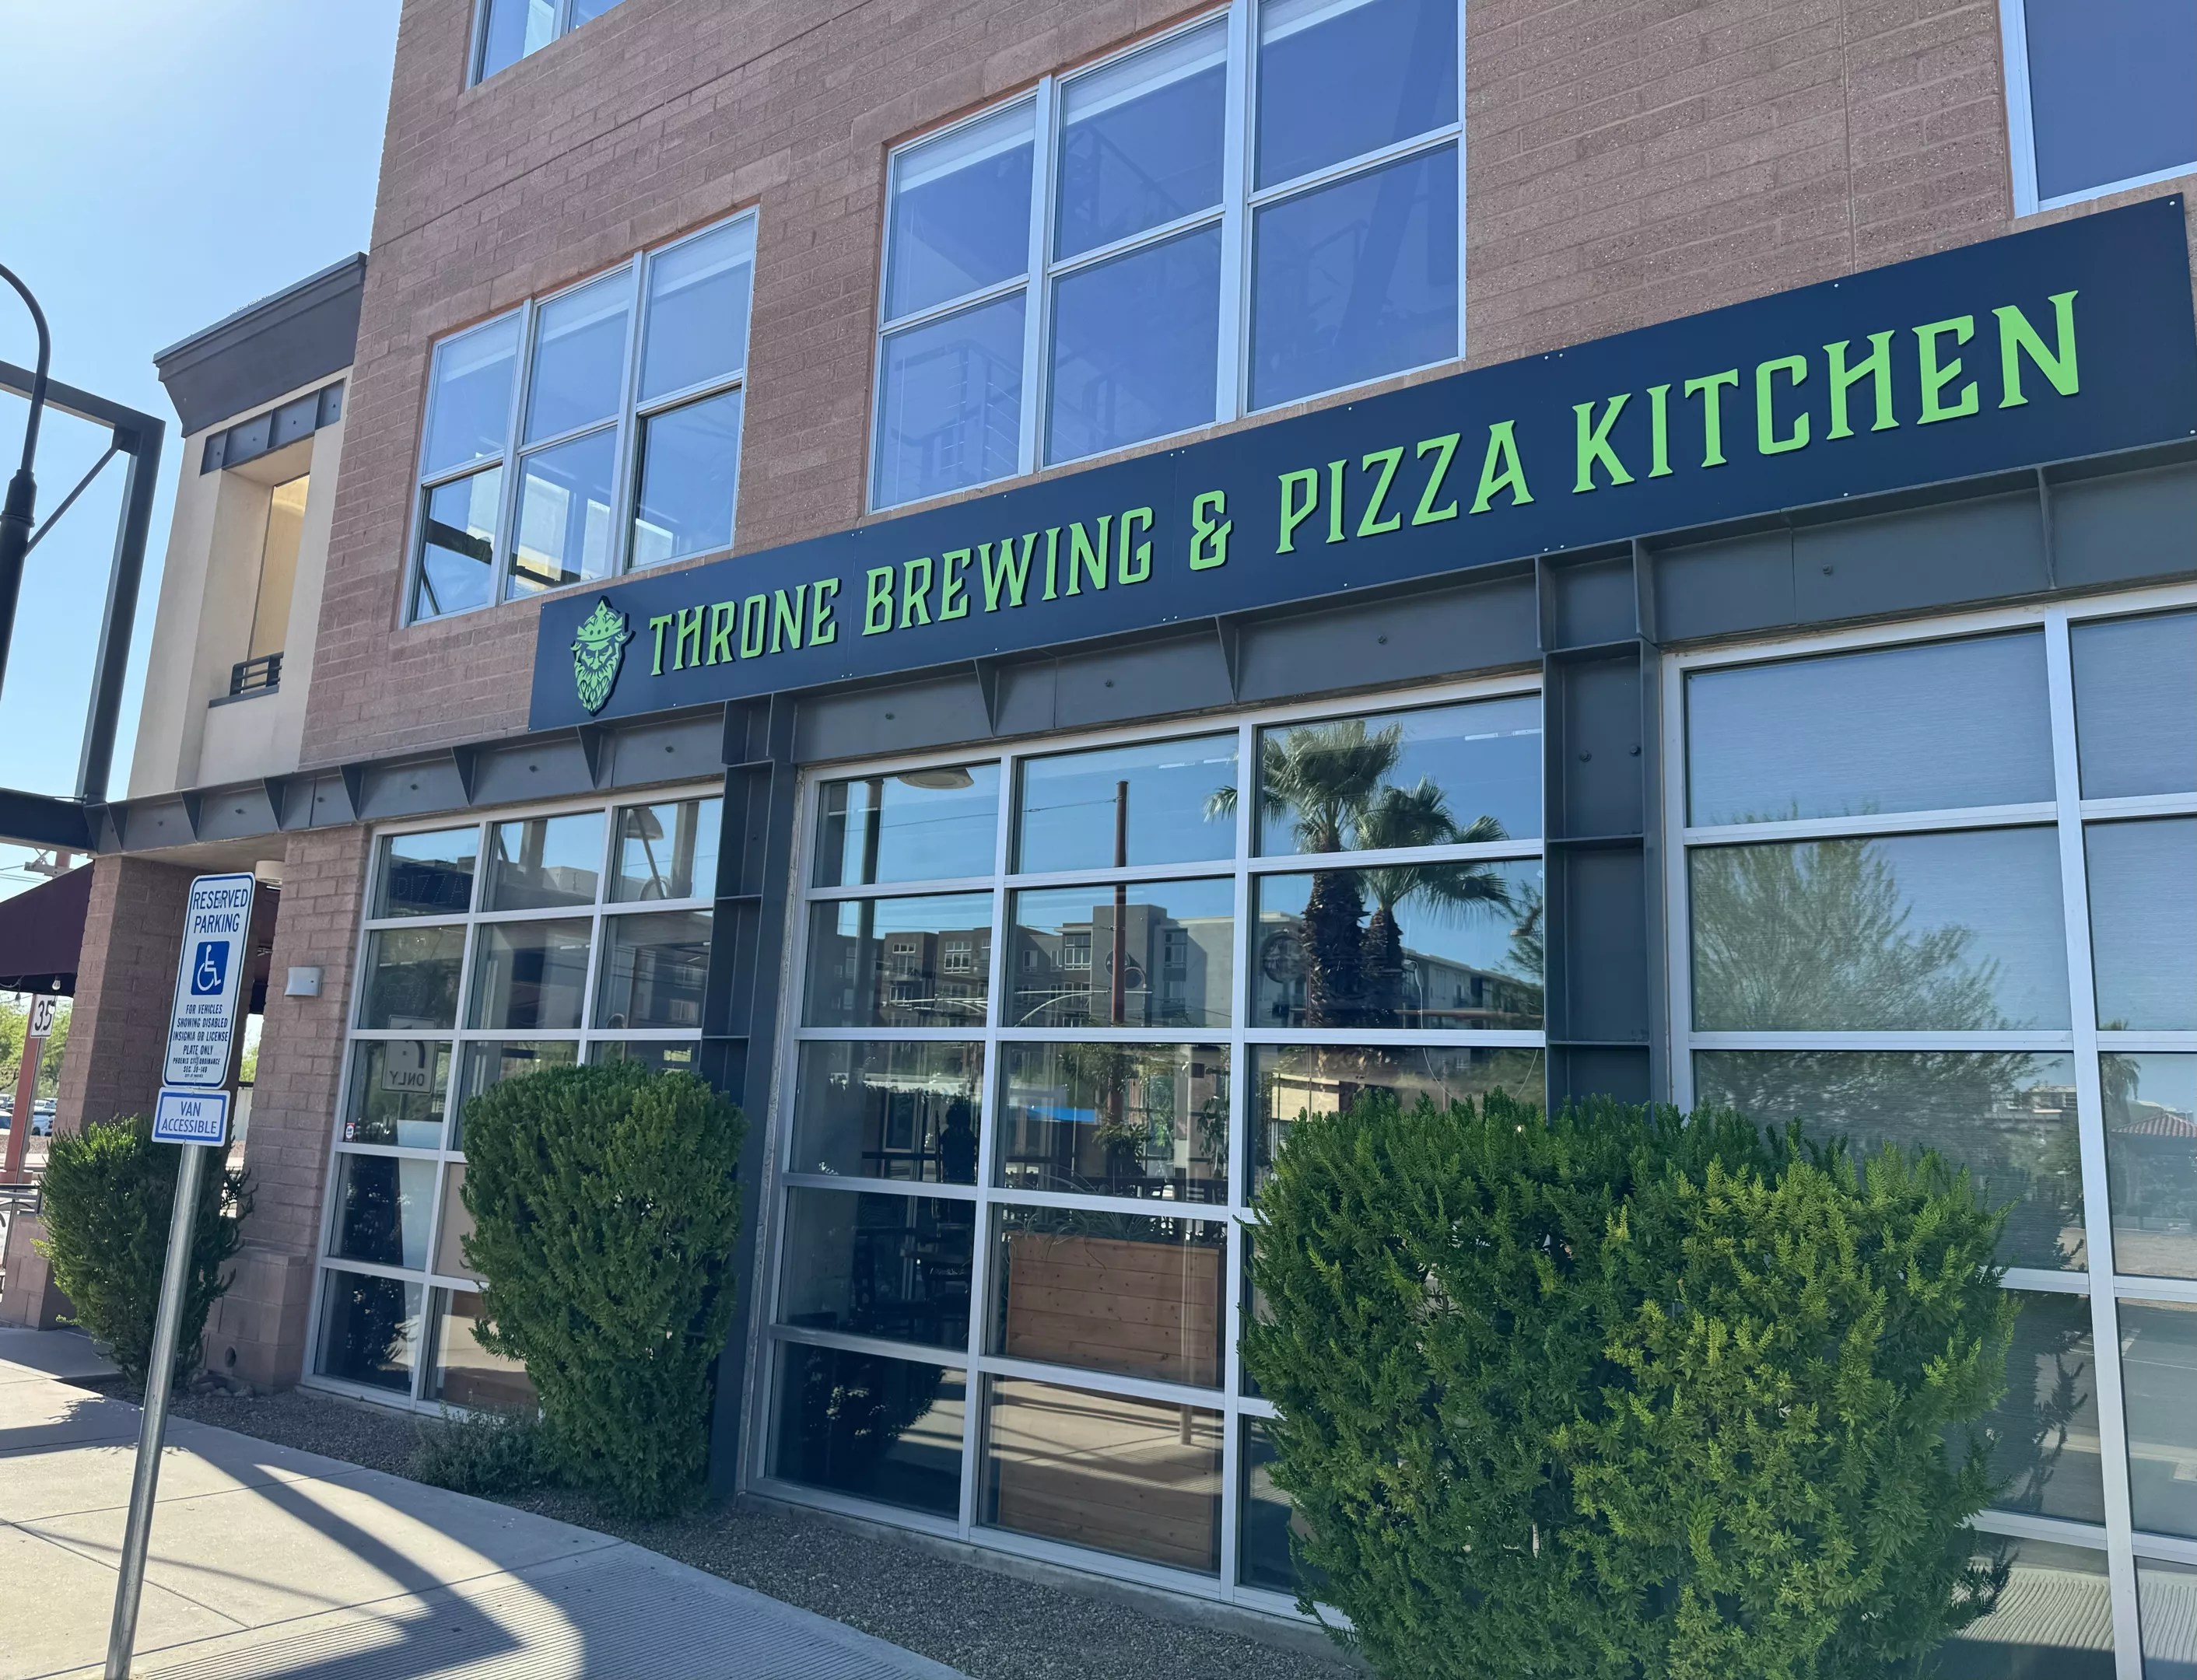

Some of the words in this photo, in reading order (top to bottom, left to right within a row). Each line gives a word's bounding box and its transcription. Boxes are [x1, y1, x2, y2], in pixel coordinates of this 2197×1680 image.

[649, 577, 841, 676] THRONE
[862, 506, 1153, 635] BREWING
[1190, 490, 1232, 571] &
[1277, 420, 1534, 555] PIZZA
[1572, 289, 2080, 495] KITCHEN
[192, 888, 248, 910] RESERVED
[193, 913, 240, 933] PARKING
[34, 1000, 55, 1031] 35
[186, 1004, 196, 1014] FOR
[198, 1004, 223, 1014] VEHICLES
[177, 1017, 201, 1027] SHOWING
[202, 1017, 228, 1027] DISABLED
[173, 1031, 195, 1041] INSIGNIA
[197, 1031, 205, 1041] OR
[206, 1031, 229, 1041] LICENSE
[183, 1045, 198, 1055] PLATE
[200, 1045, 214, 1055] ONLY
[180, 1101, 201, 1117] VAN
[161, 1118, 217, 1134] ACCESSIBLE
